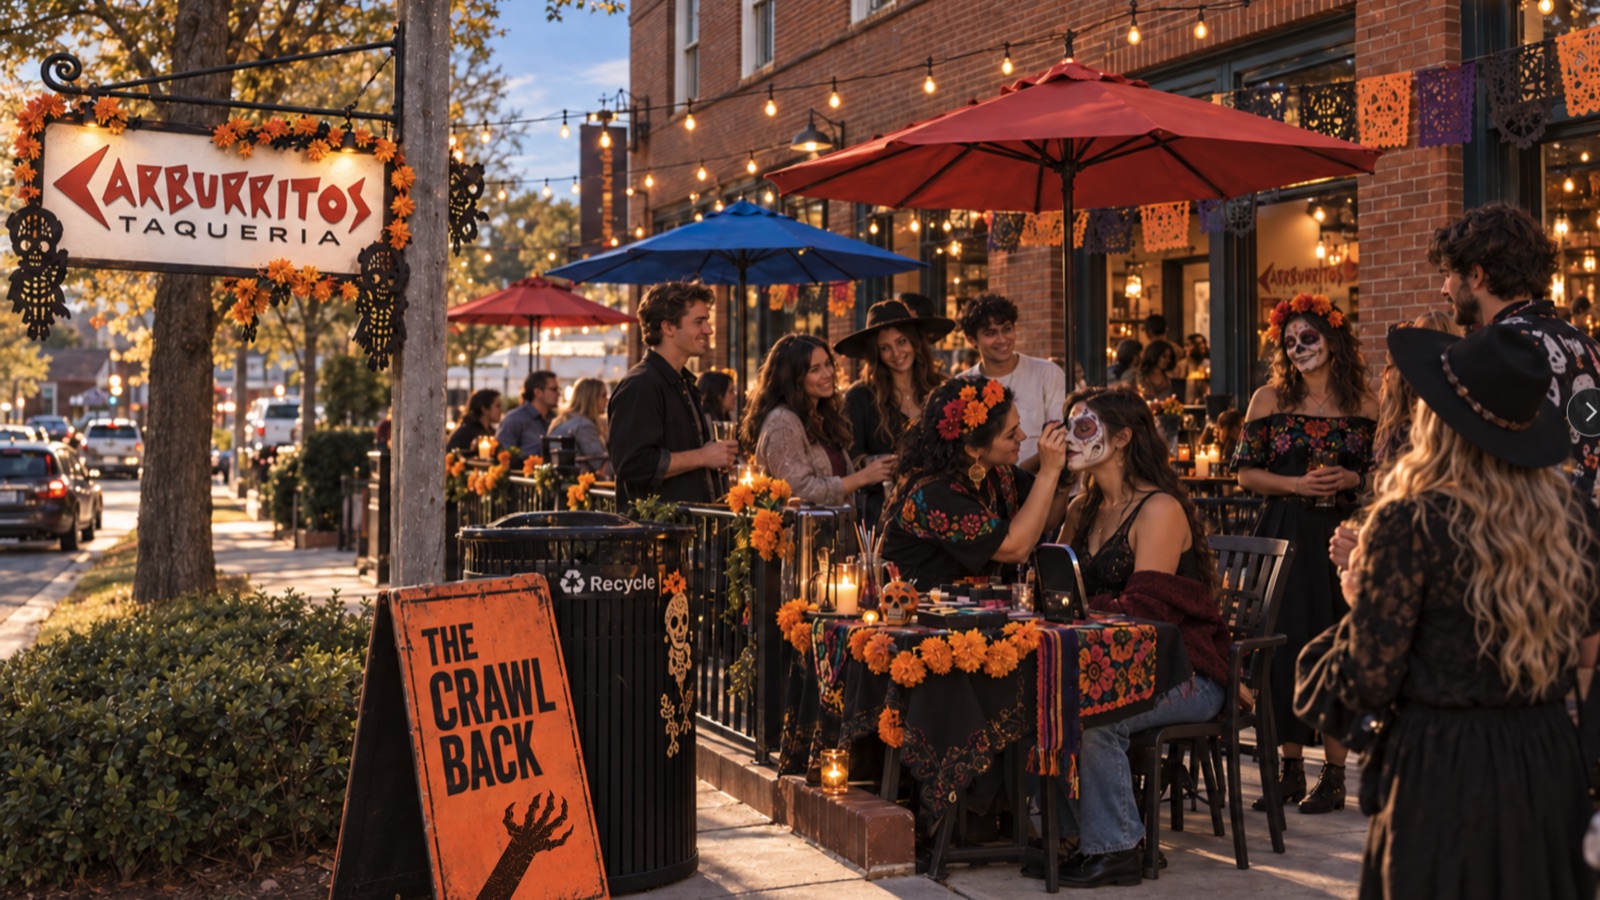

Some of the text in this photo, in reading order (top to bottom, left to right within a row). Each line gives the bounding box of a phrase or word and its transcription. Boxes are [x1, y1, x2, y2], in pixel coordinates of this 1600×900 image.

[53, 144, 372, 233] CARBURRITOS
[118, 215, 341, 247] TAQUERIA
[589, 574, 656, 595] Recycle
[421, 622, 479, 667] THE
[429, 657, 557, 732] CRAWL
[438, 719, 544, 797] BACK
